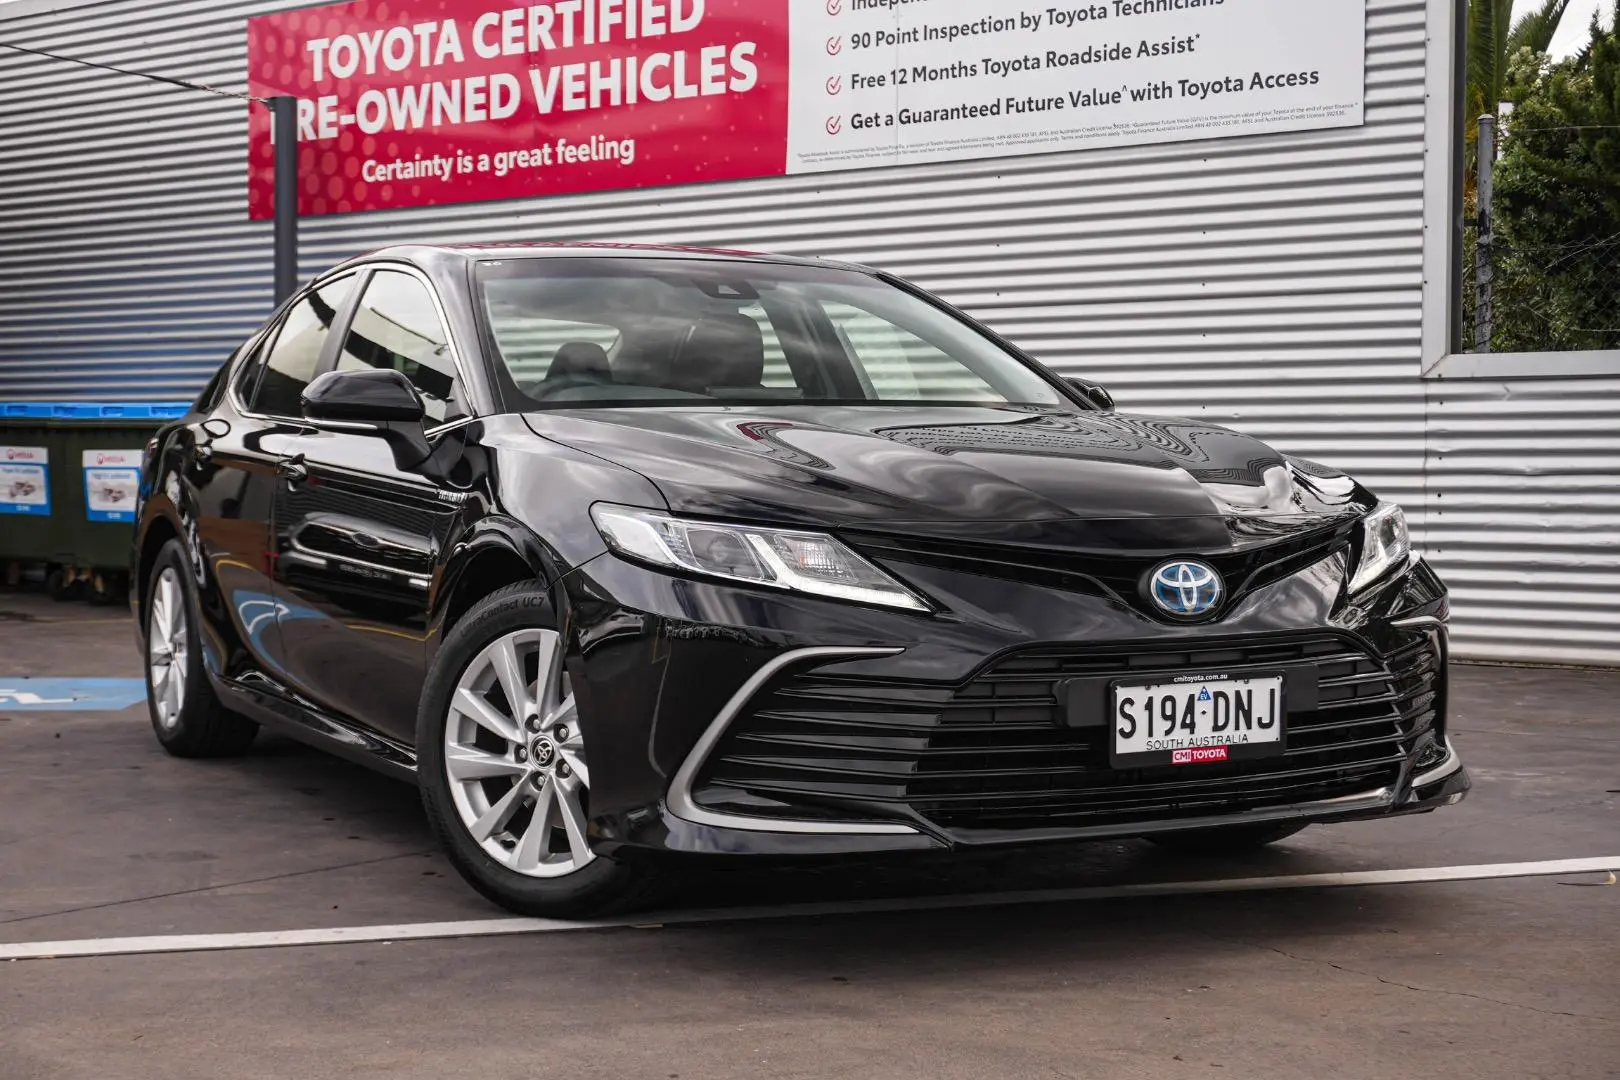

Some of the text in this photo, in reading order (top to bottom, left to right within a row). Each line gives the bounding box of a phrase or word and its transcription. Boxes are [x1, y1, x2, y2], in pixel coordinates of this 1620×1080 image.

[306, 0, 705, 82] TOYOTA CERTIFIED
[851, 32, 871, 50] 90
[876, 27, 919, 47] Point
[923, 15, 1016, 42] Inspection
[1020, 12, 1041, 32] by
[1046, 6, 1107, 27] Toyota
[529, 41, 759, 115] VEHICLES
[851, 71, 886, 90] Free
[890, 69, 908, 85] 12
[912, 61, 977, 83] Months
[982, 55, 1041, 77] Toyota
[1046, 43, 1131, 68] Roadside
[851, 111, 880, 130] Get
[885, 114, 894, 127] a
[898, 99, 1000, 125] Guaranteed
[1005, 94, 1064, 114] Future
[1130, 81, 1173, 101] with
[1178, 76, 1244, 100] Toyota
[1249, 70, 1319, 91] Access
[362, 135, 635, 183] Certainty is a great feeling
[524, 597, 545, 608] UC7
[1174, 674, 1228, 683] cmitoyota.com.au
[1146, 733, 1249, 751] SOUTH AUSTRALIA
[1174, 748, 1227, 761] CMI TOYOTA
